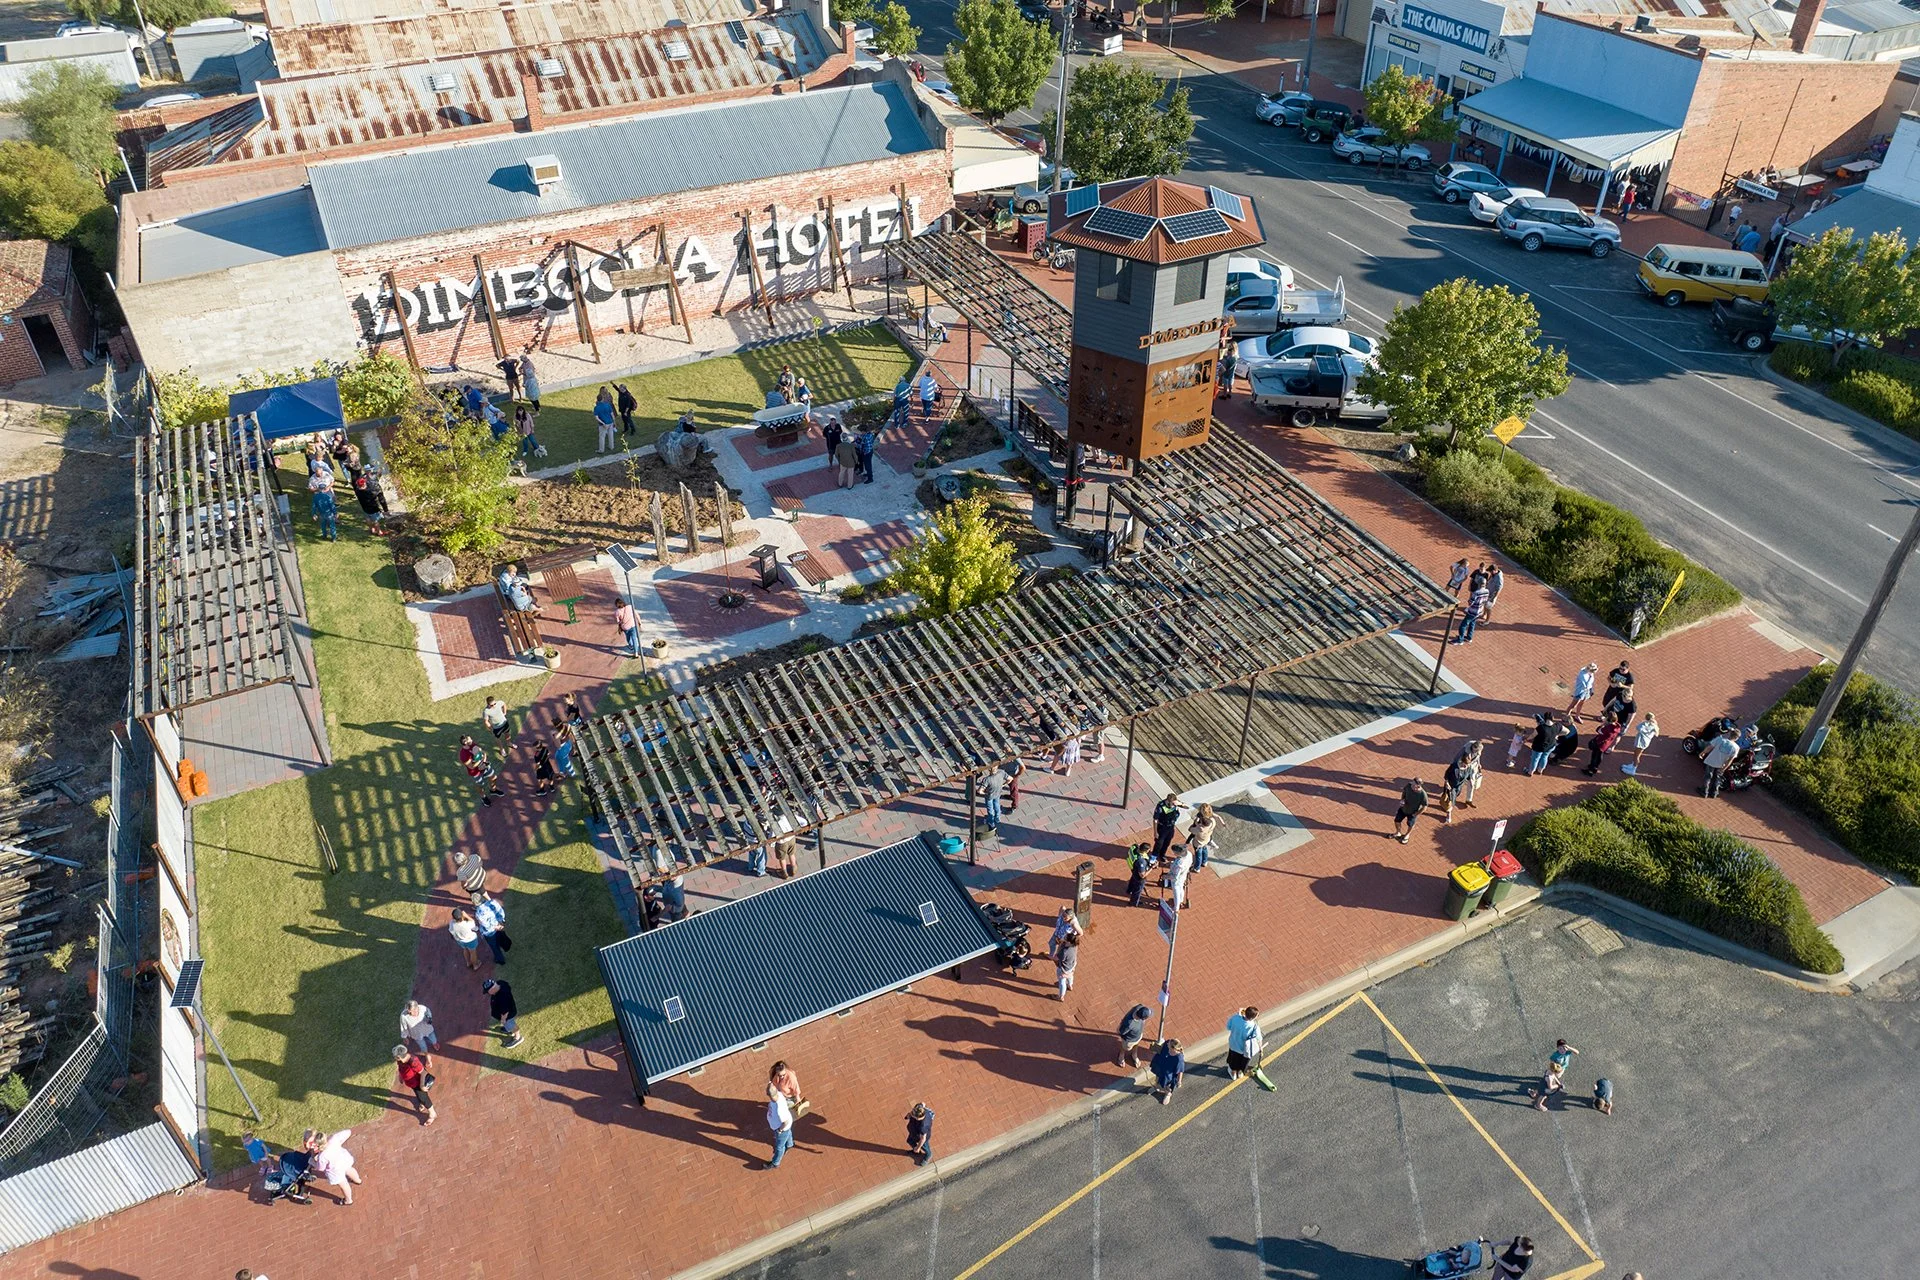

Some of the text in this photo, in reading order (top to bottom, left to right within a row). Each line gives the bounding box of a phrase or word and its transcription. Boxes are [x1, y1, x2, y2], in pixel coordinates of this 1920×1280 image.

[1424, 15, 1462, 40] CANVAS
[1462, 27, 1487, 49] MAN
[1461, 62, 1495, 81] FISHING LURES
[1139, 315, 1237, 349] DIMBOOLA
